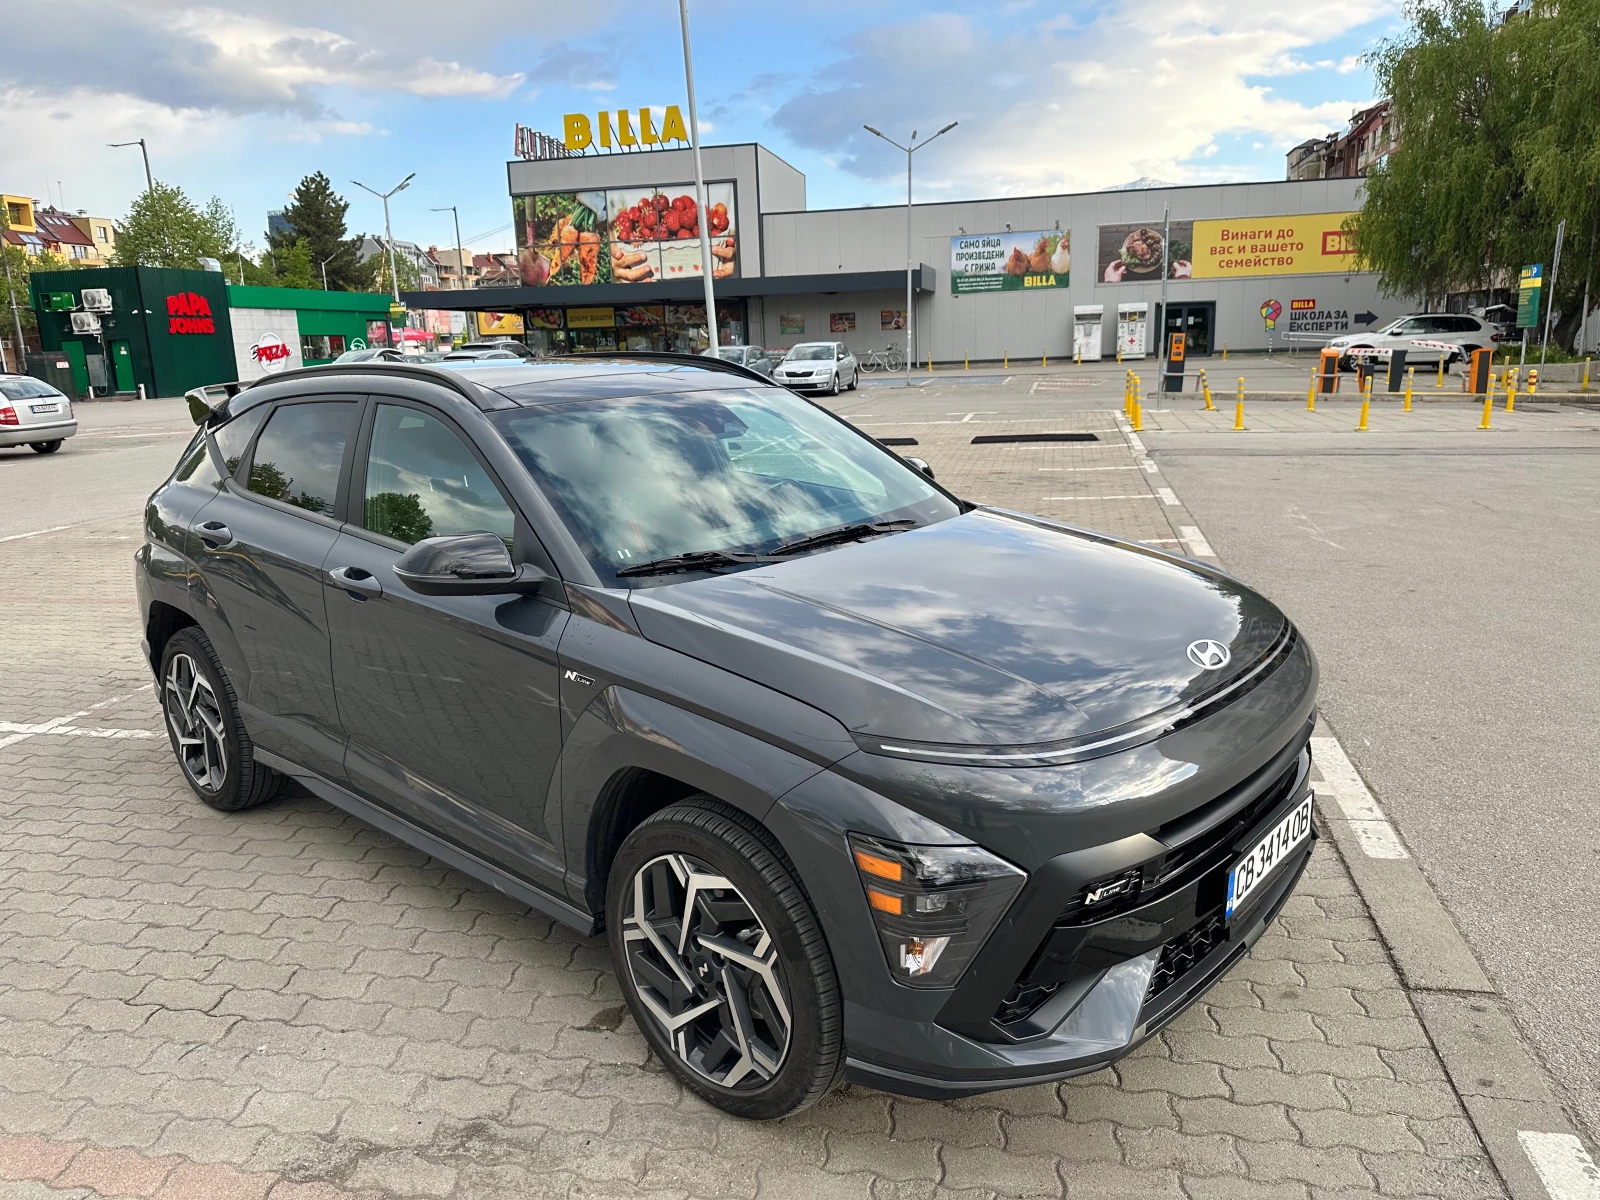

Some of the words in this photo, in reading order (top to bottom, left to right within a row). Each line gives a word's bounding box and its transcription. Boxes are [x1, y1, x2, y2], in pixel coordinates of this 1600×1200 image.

[563, 105, 688, 150] BILLA
[1221, 229, 1273, 242] Винаги
[1276, 228, 1294, 240] до
[959, 239, 980, 250] САМО
[981, 237, 1001, 249] ЯЙЦА
[1210, 245, 1234, 256] вас
[1237, 244, 1246, 254] и
[1250, 242, 1304, 254] вашето
[955, 250, 1005, 262] ПРОИЗВЕДЕНИ
[1218, 255, 1294, 269] семейство
[964, 263, 969, 272] С
[970, 262, 996, 273] ГРИЖА
[1024, 275, 1056, 287] BILLA
[166, 291, 213, 316] PAPA
[1292, 300, 1314, 309] BILLA
[569, 315, 589, 323] ДОБРЕ
[589, 314, 613, 323] ДОШЛИ
[1289, 310, 1333, 321] ШКОЛА
[1333, 310, 1349, 320] ЗА
[168, 317, 216, 335] JOHNS
[1289, 320, 1349, 332] ЕКСПЕРТИ
[564, 669, 578, 681] N
[1236, 855, 1255, 900] CB
[1256, 818, 1291, 878] 3414
[1292, 802, 1309, 842] OB
[1084, 888, 1103, 905] N
